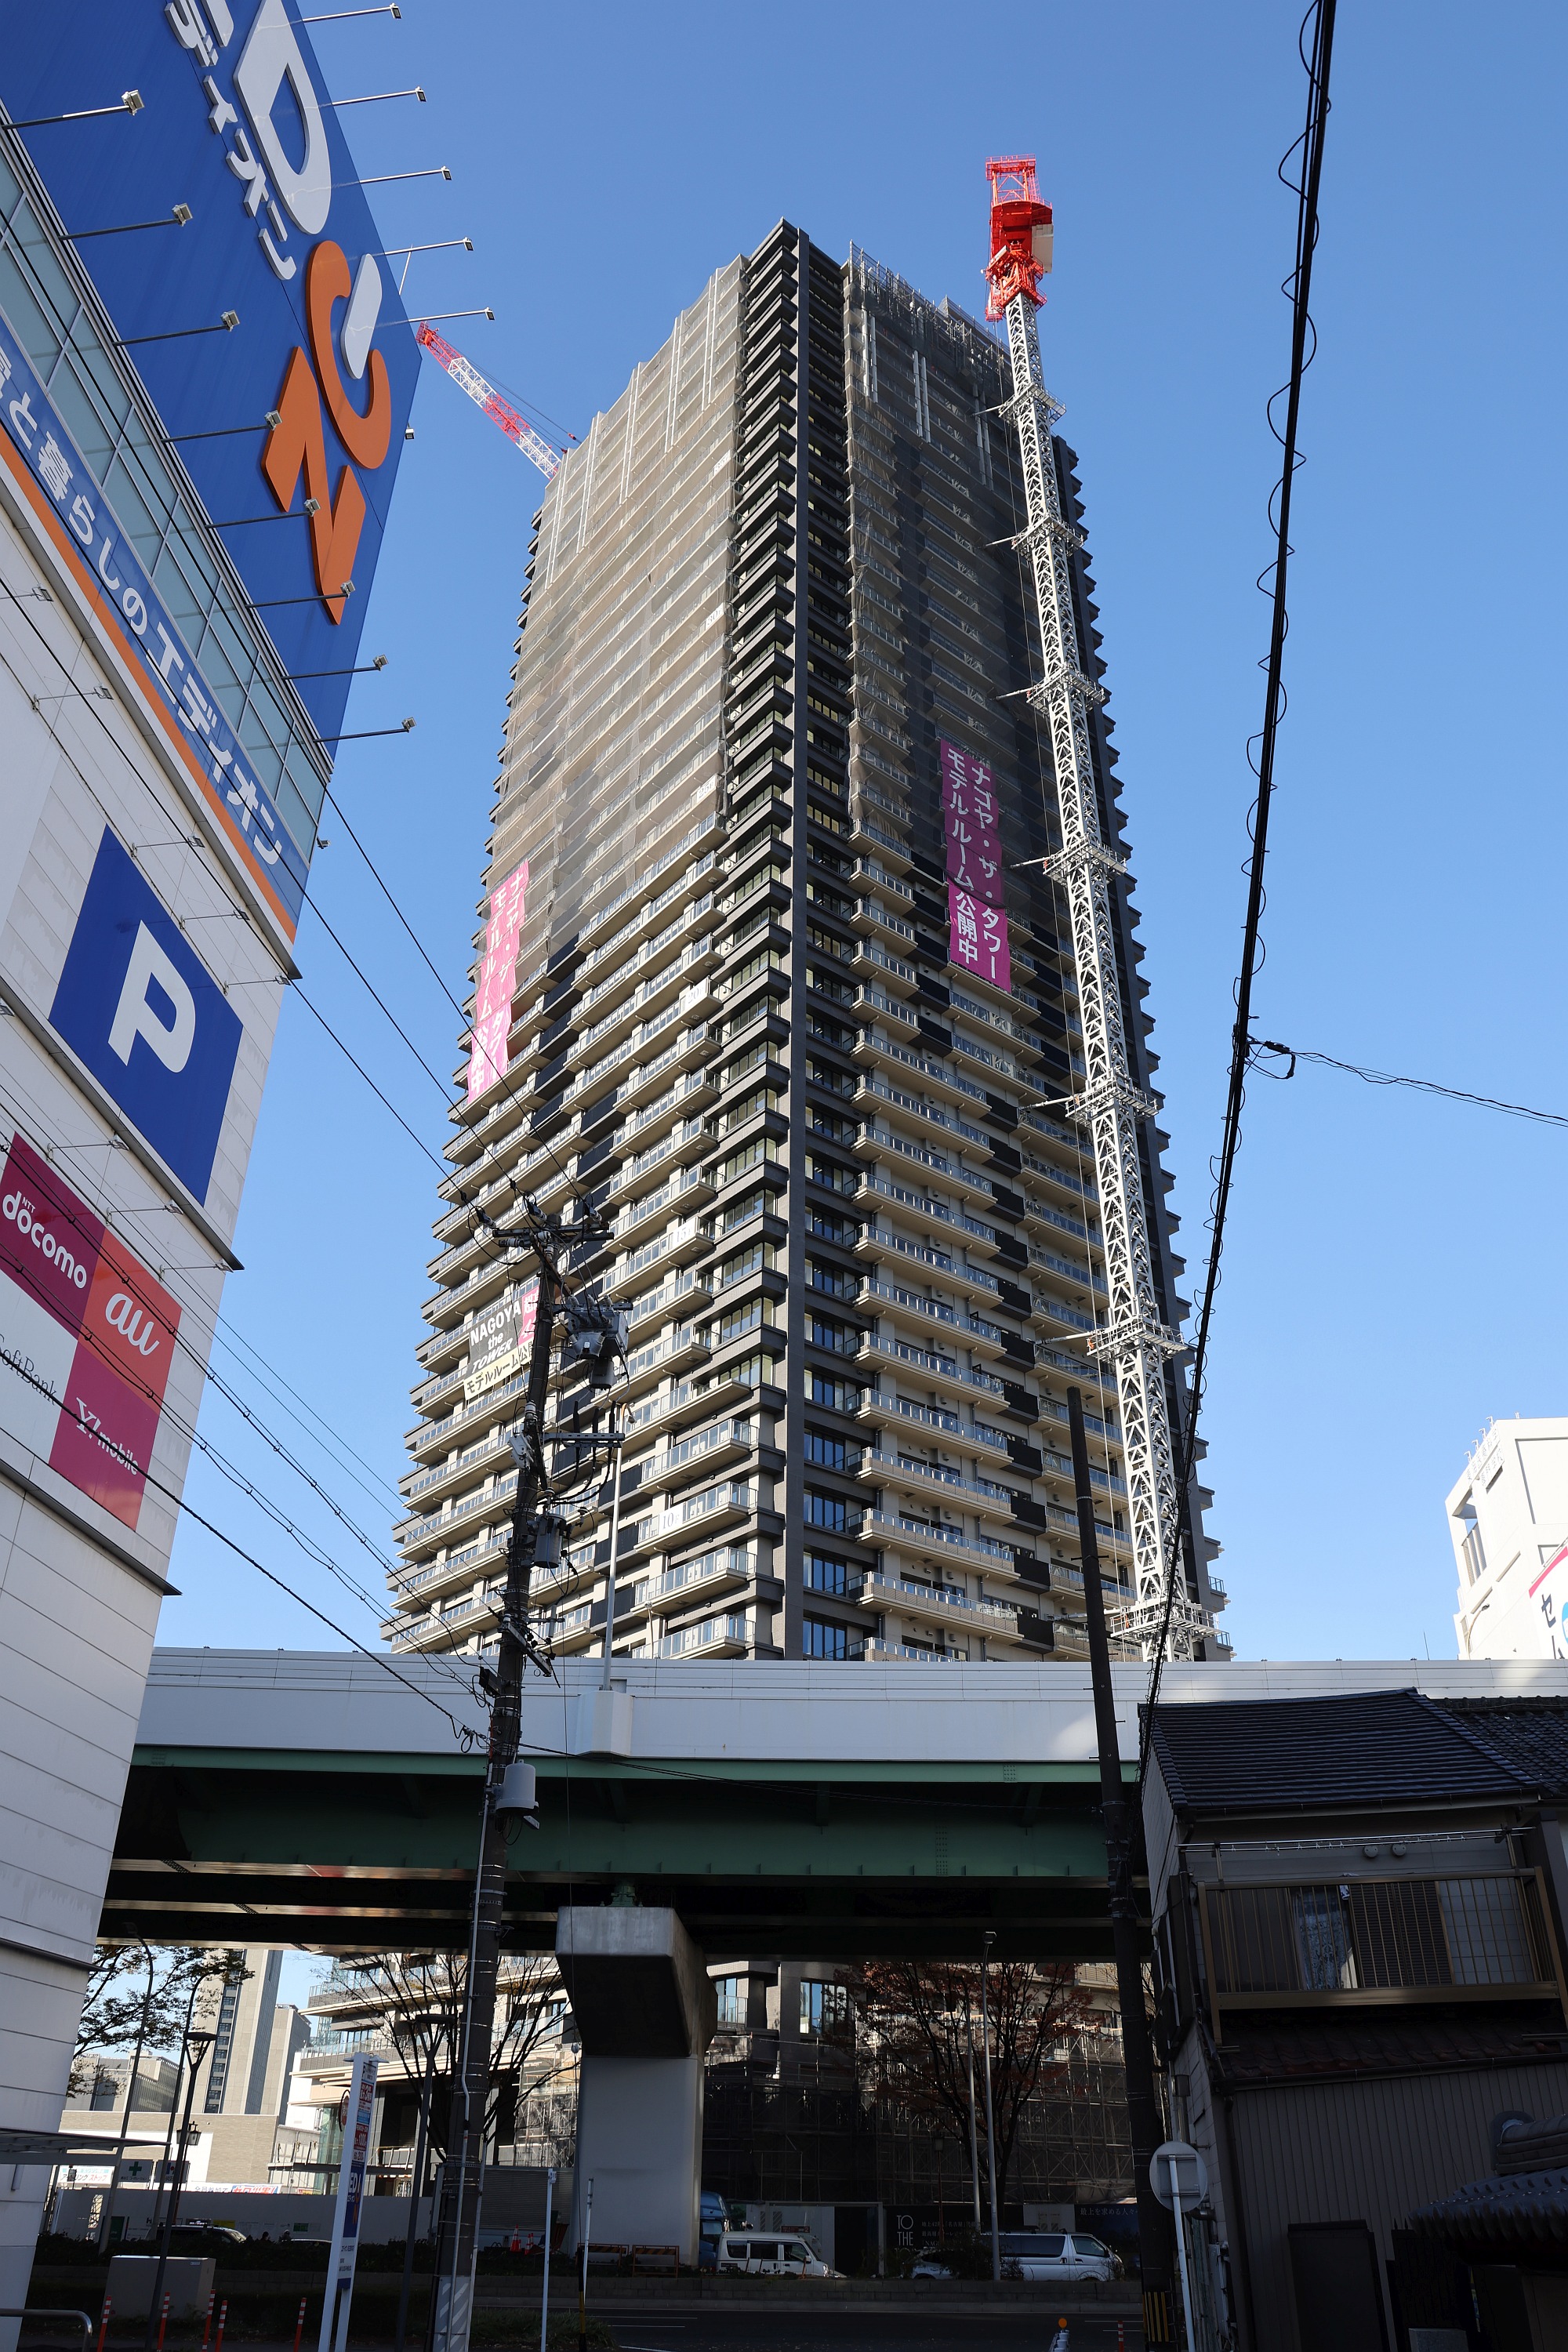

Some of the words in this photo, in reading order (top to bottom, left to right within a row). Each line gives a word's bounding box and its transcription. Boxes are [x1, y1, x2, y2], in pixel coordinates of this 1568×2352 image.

[947, 747, 978, 964] モデルルーム公開中
[107, 920, 195, 1073] P
[22, 1196, 35, 1214] NTT
[2, 1191, 87, 1289] docomo
[106, 1293, 160, 1356] au
[470, 1300, 521, 1346] NAGOYA
[488, 1332, 503, 1350] the
[0, 1334, 56, 1406] oftBank
[472, 1338, 514, 1374] TOWER
[896, 2215, 913, 2230] TO
[897, 2231, 914, 2246] THE
